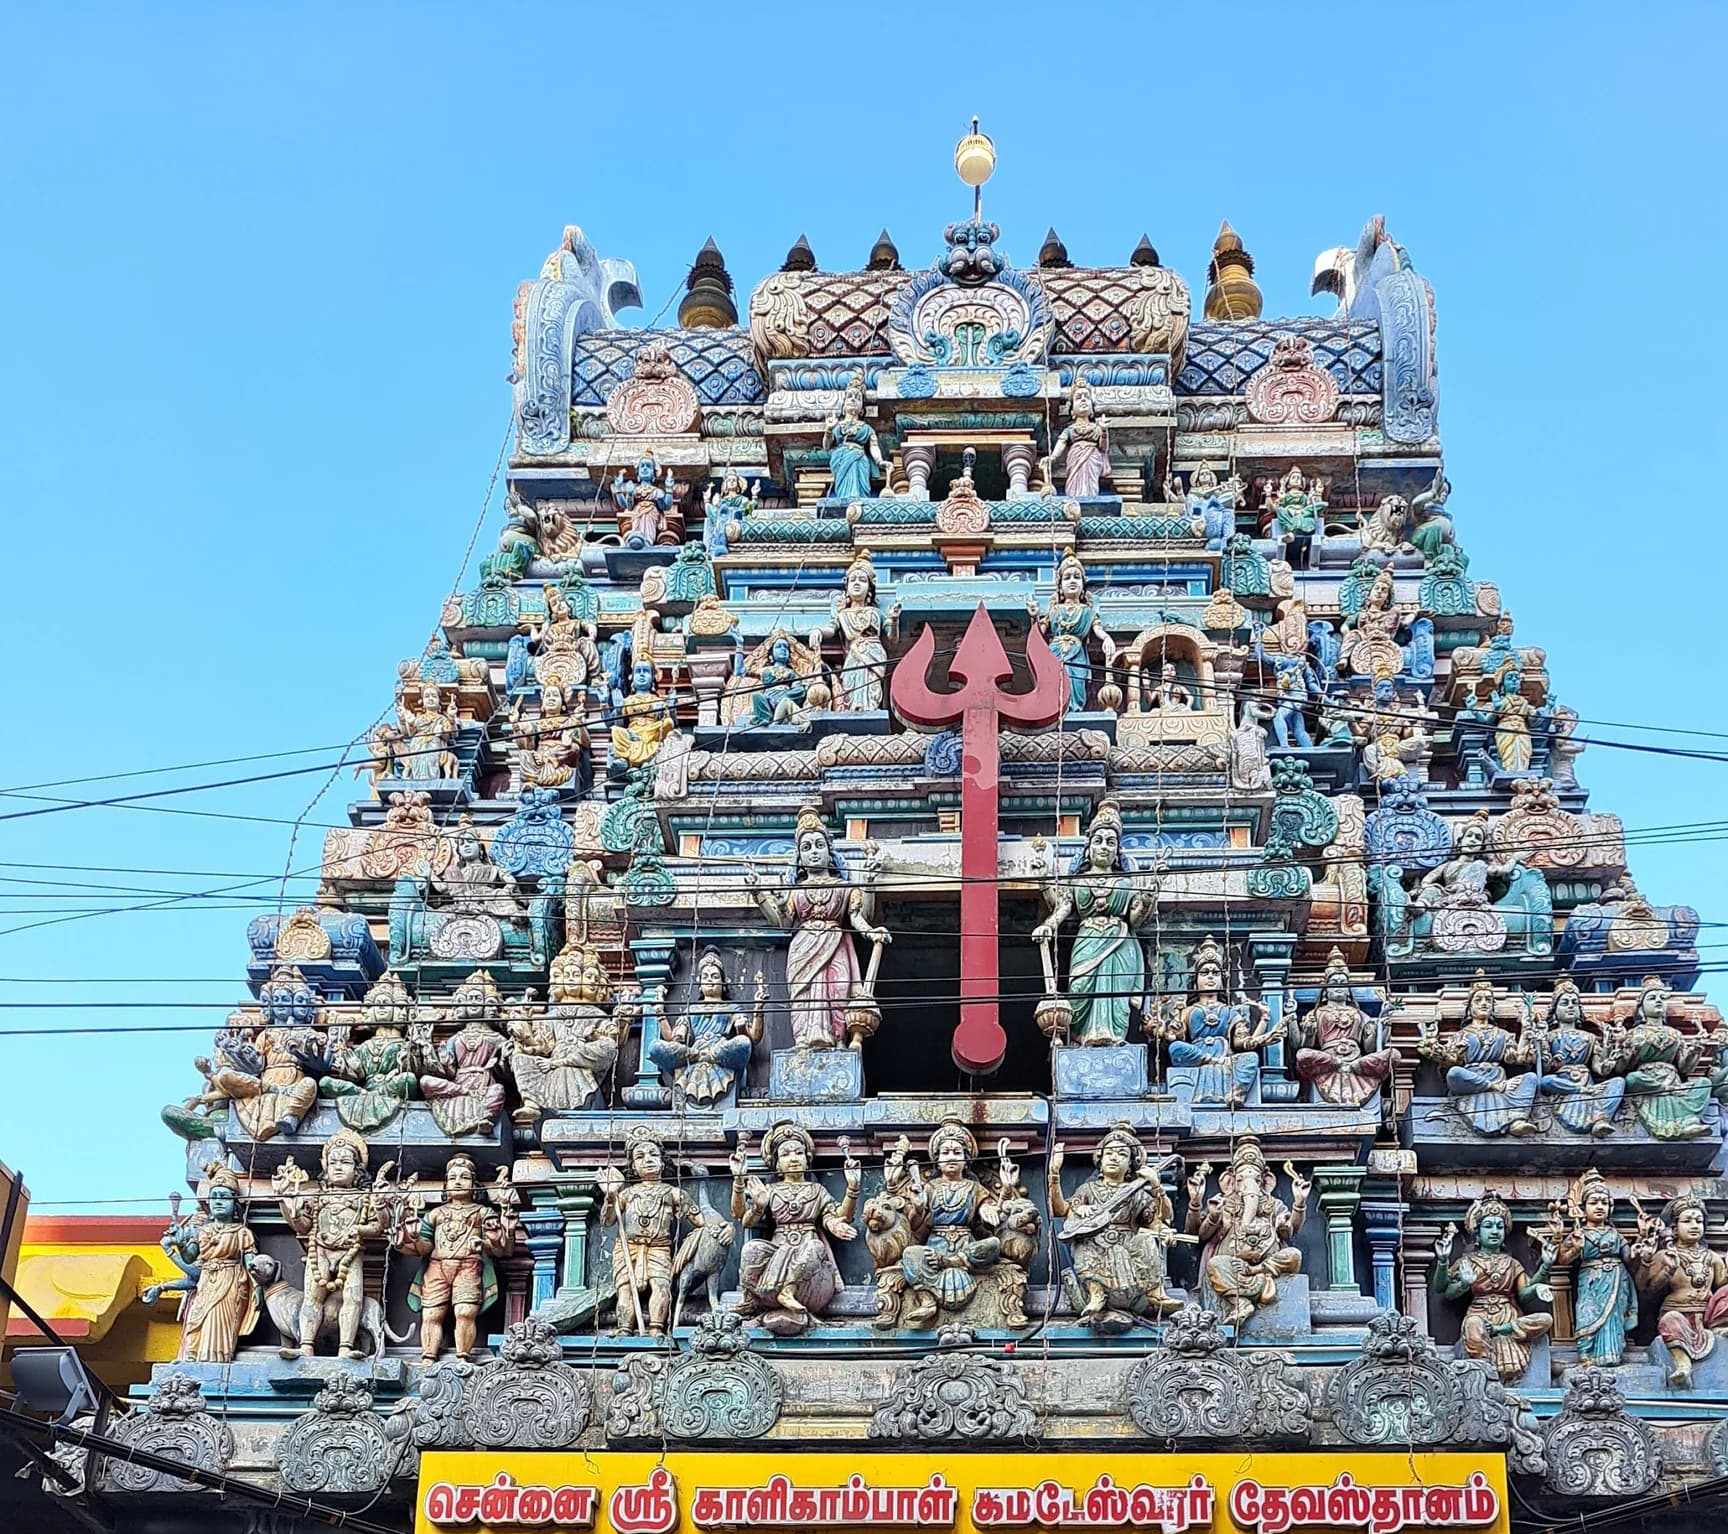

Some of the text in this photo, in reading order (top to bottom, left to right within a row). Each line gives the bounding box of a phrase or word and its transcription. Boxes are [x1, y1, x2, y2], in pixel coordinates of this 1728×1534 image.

[428, 1475, 592, 1520] சென்னை
[612, 1471, 673, 1531] ஸ்ரீ
[694, 1476, 954, 1522] காளிகாம்பாள்
[1233, 1475, 1496, 1534] தேவஸ்தானம்
